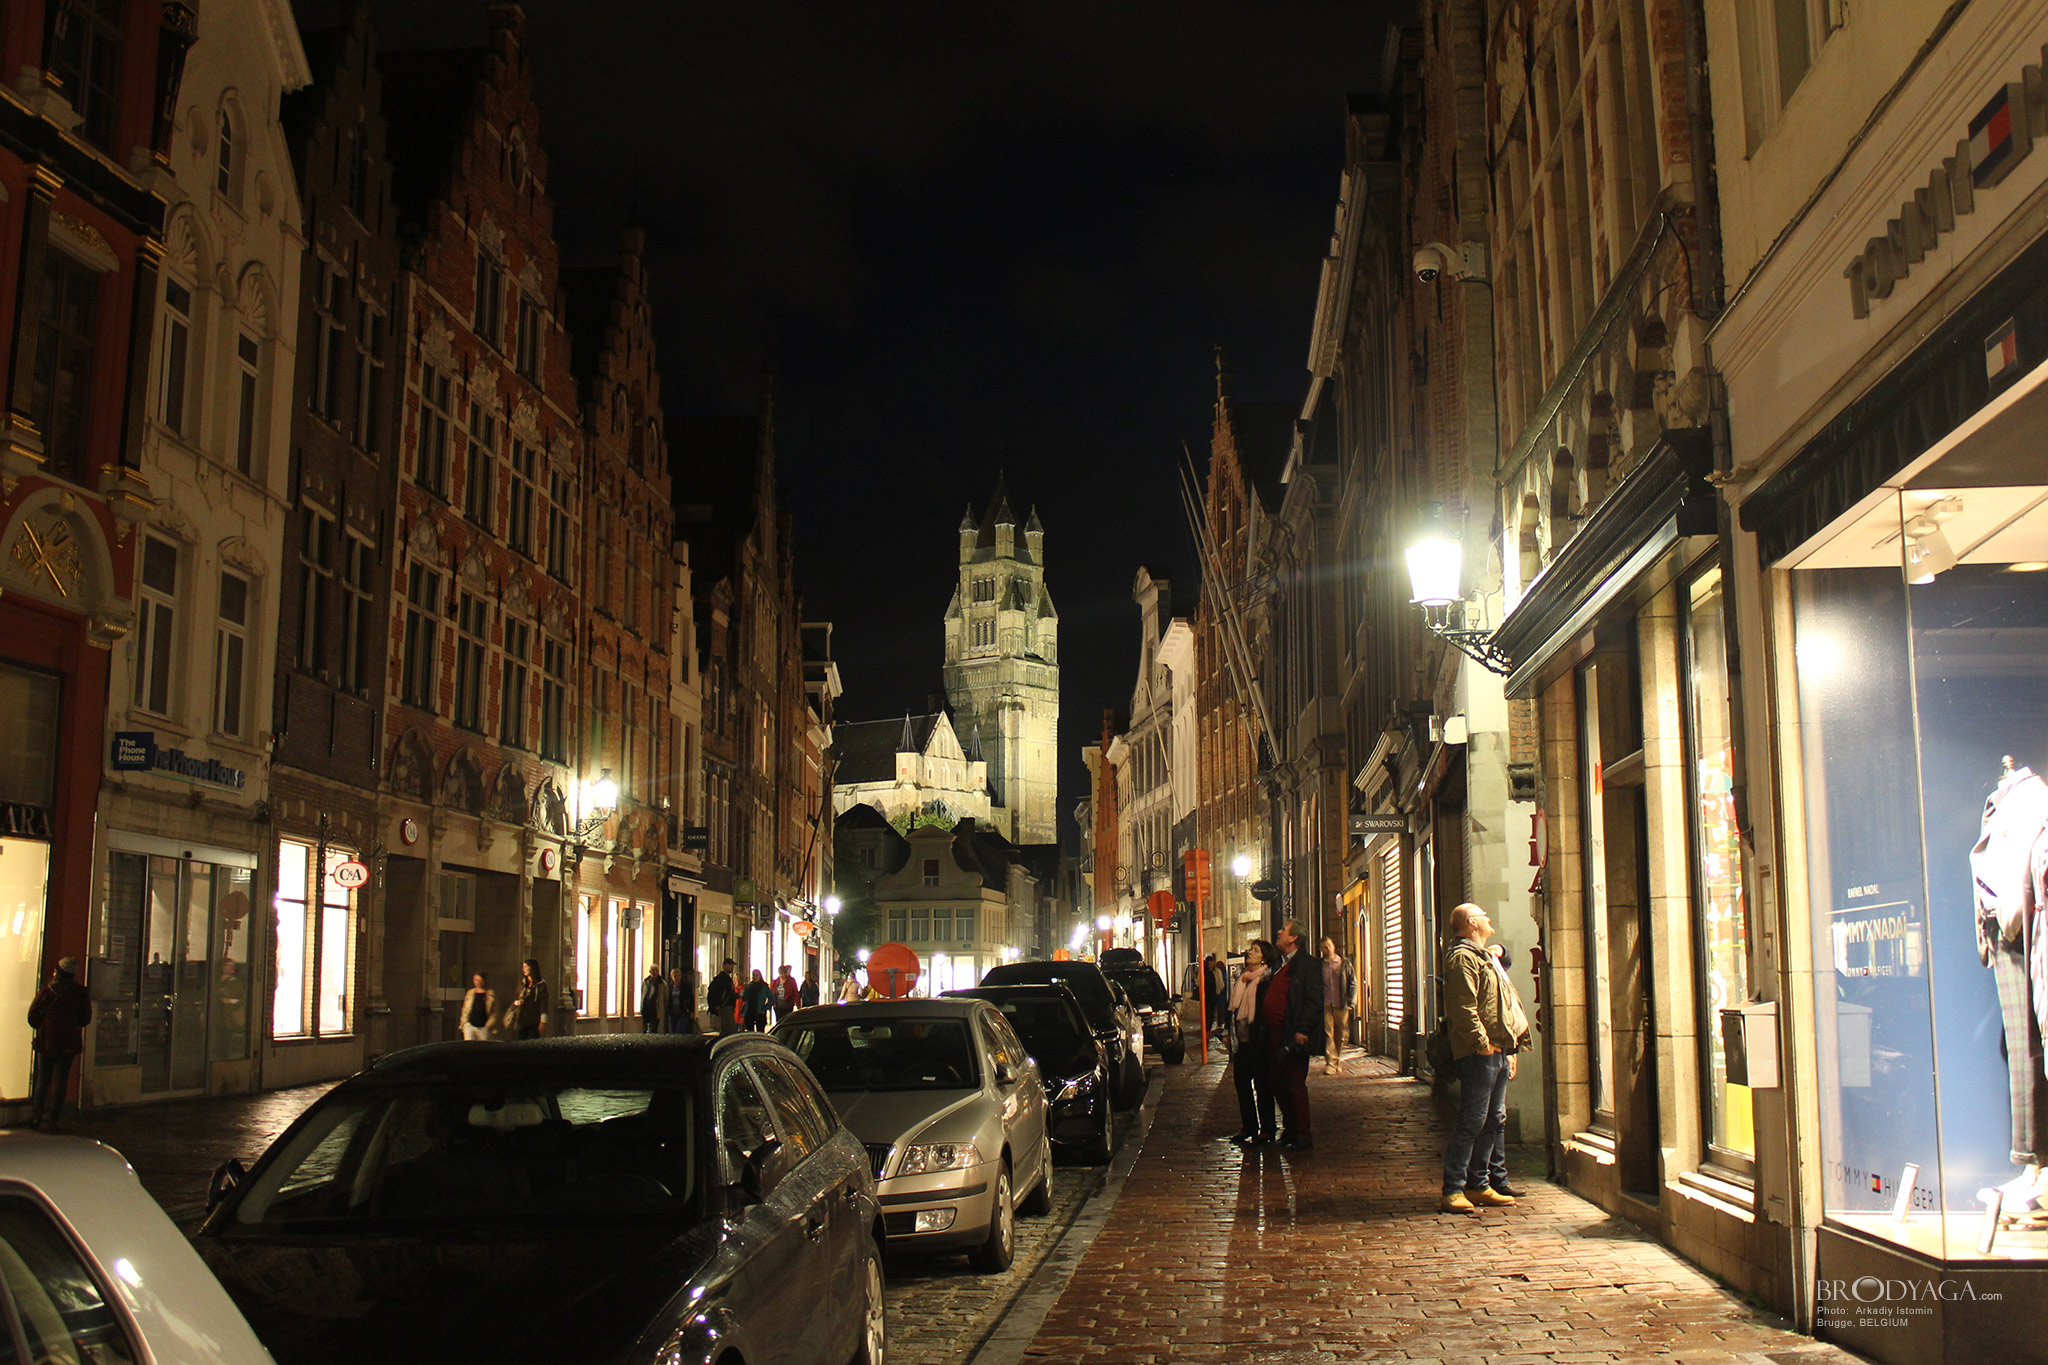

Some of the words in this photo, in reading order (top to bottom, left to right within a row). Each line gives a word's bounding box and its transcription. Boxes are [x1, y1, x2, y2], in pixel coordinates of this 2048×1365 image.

[119, 739, 137, 747] The
[119, 747, 146, 755] Phone
[119, 754, 146, 762] House
[208, 758, 246, 788] House
[0, 803, 53, 838] ARA
[1364, 820, 1404, 828] SWAROVSKI
[339, 868, 363, 881] C&A
[1832, 915, 1907, 943] MMYXNADAL
[1828, 1161, 1868, 1190] TOMMY
[1883, 1177, 1935, 1211] HIGER
